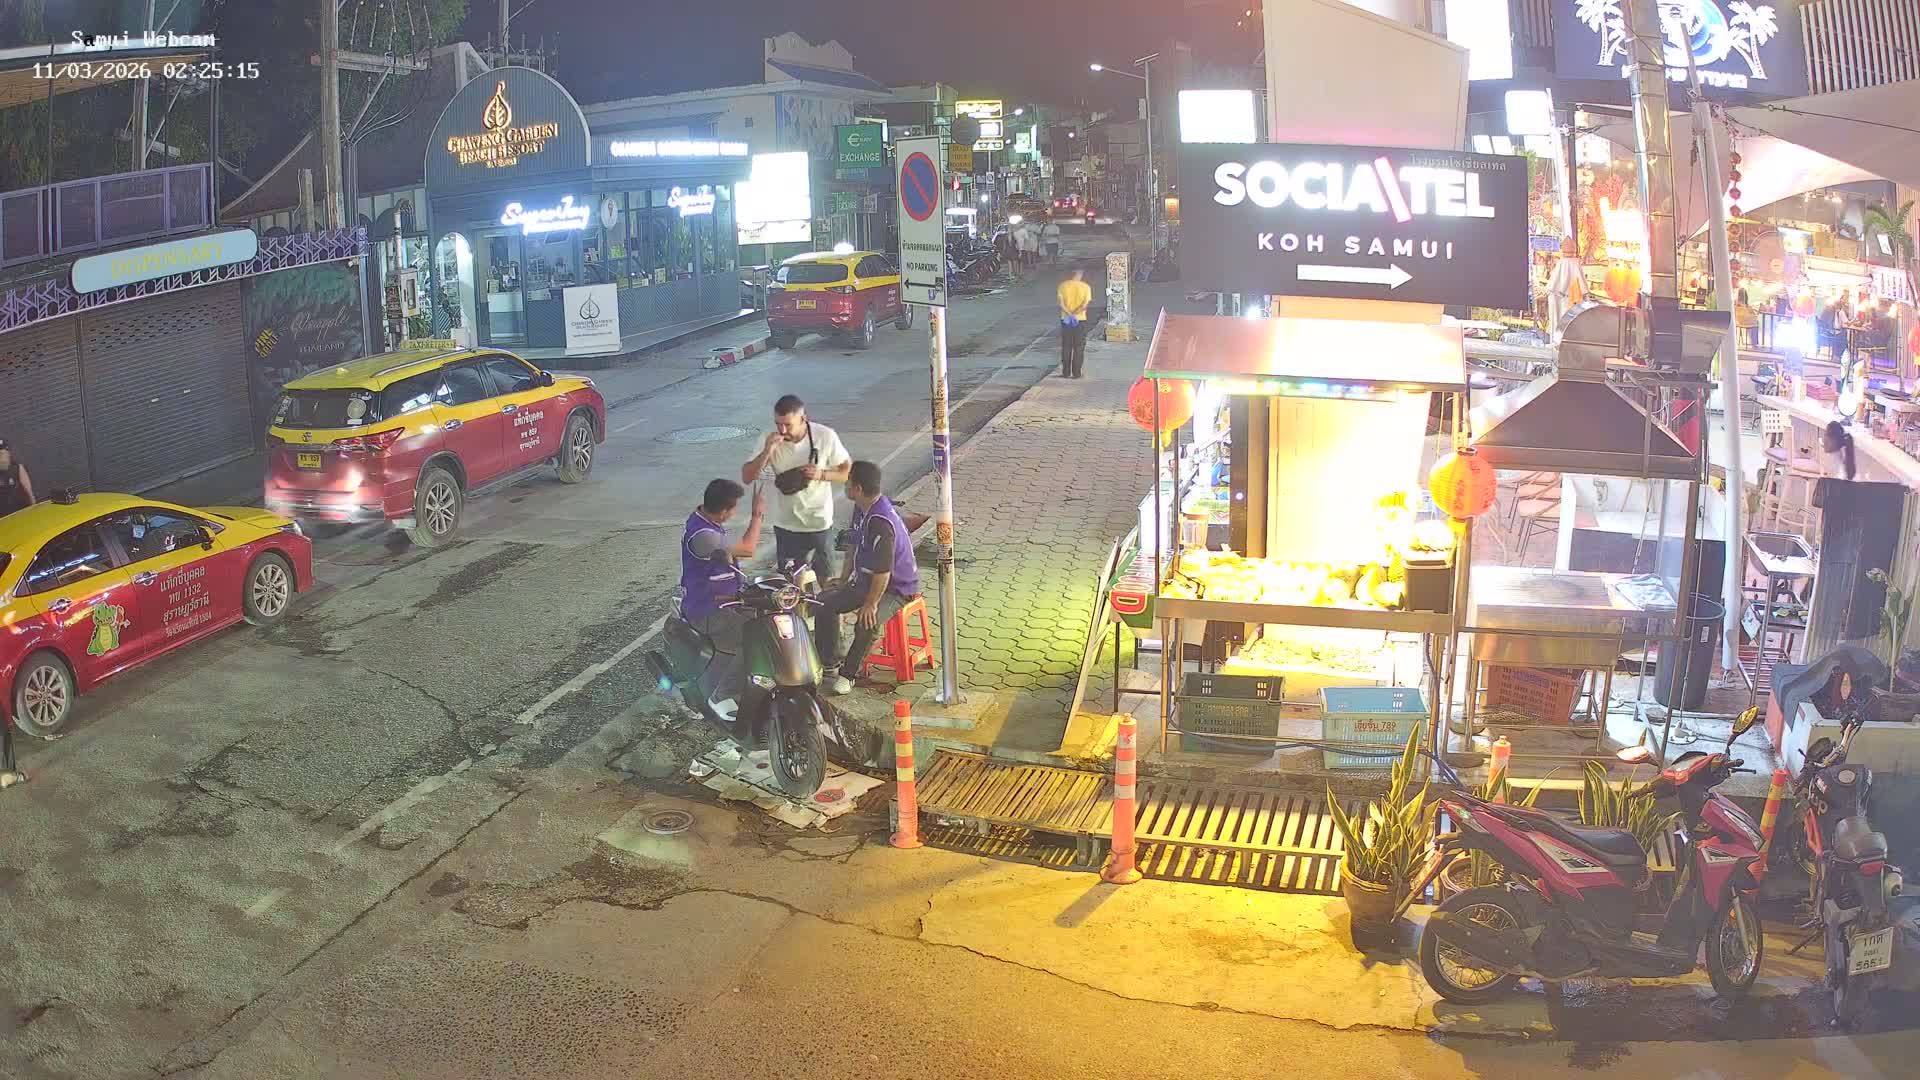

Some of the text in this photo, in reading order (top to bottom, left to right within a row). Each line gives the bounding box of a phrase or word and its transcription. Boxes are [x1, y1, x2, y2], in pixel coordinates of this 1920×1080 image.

[840, 152, 880, 162] EXCHANGE
[1257, 232, 1454, 259] KOH SAMUI
[111, 241, 225, 281] DISPENSARY
[906, 262, 939, 272] NO PARKING
[300, 343, 345, 353] THAILAND
[160, 566, 205, 592] แท็กซี่บุคคล
[183, 582, 202, 599] 1132
[163, 591, 210, 626] สุราษฎร์ธานี
[1381, 720, 1397, 730] 789
